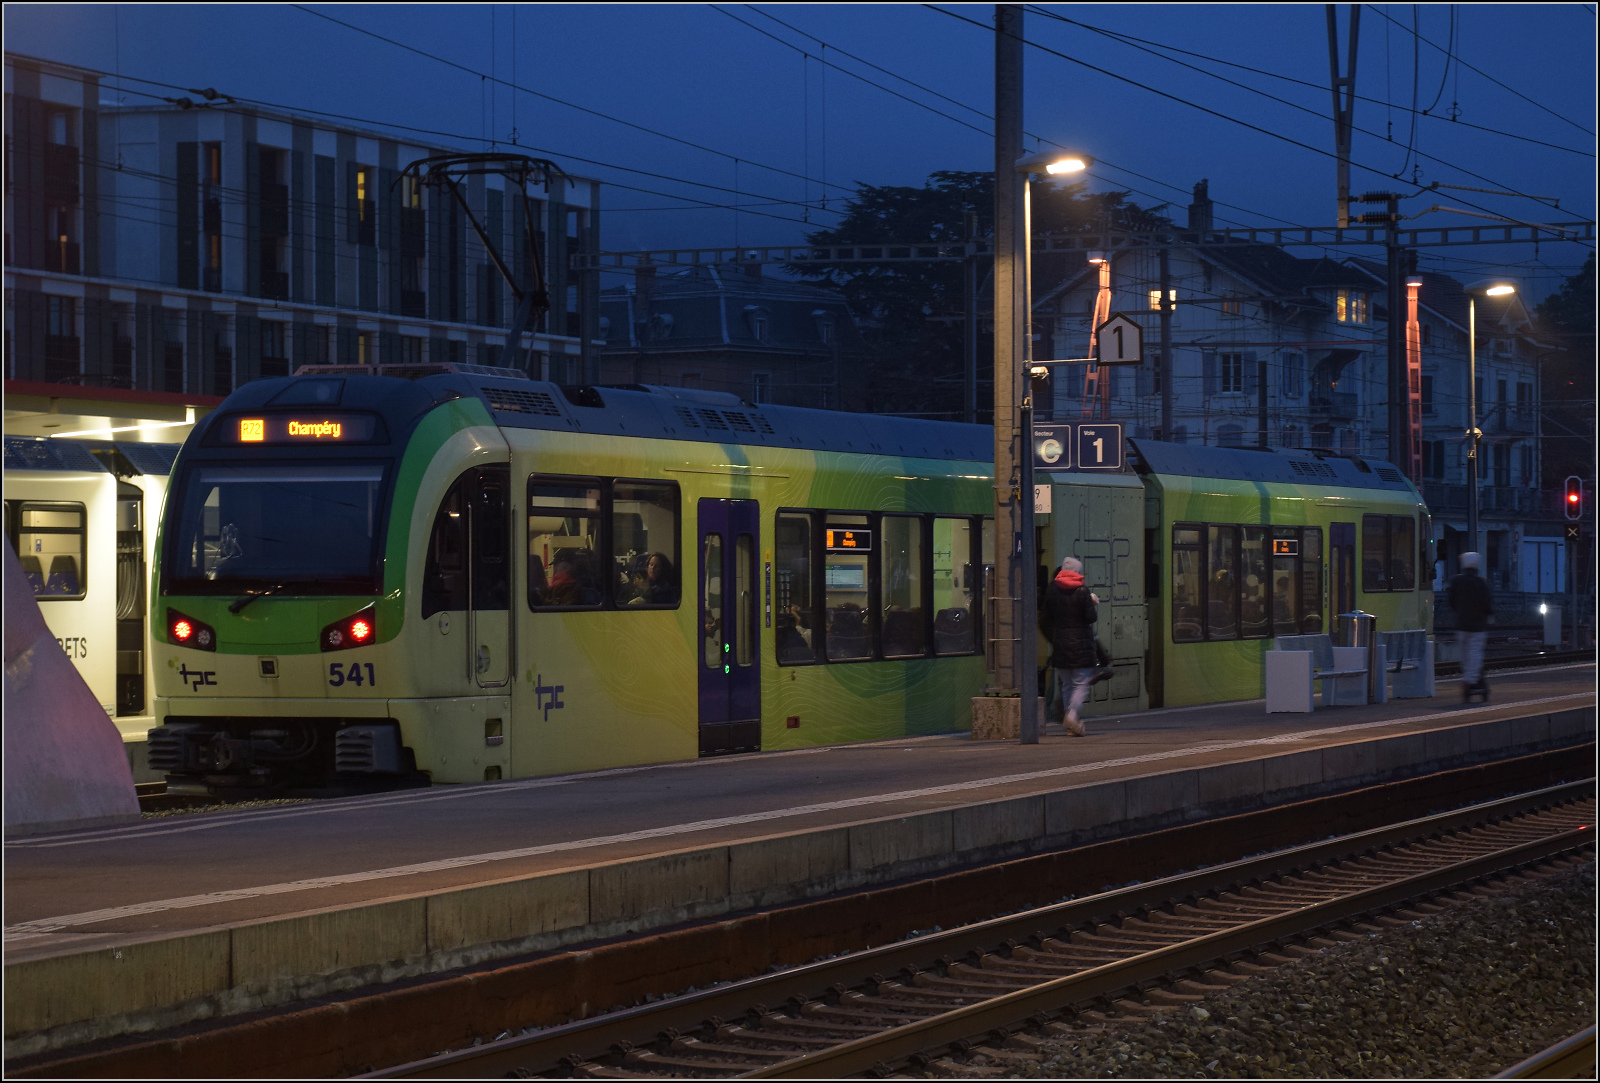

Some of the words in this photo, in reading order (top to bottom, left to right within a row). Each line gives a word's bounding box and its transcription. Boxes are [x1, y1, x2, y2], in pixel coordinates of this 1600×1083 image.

[1112, 325, 1124, 359] 1
[242, 422, 262, 438] R72
[288, 421, 342, 438] Champéry
[1040, 438, 1060, 464] C
[1092, 437, 1103, 463] 1
[179, 663, 218, 692] tpc
[329, 662, 376, 687] 541
[534, 674, 565, 723] tpc
